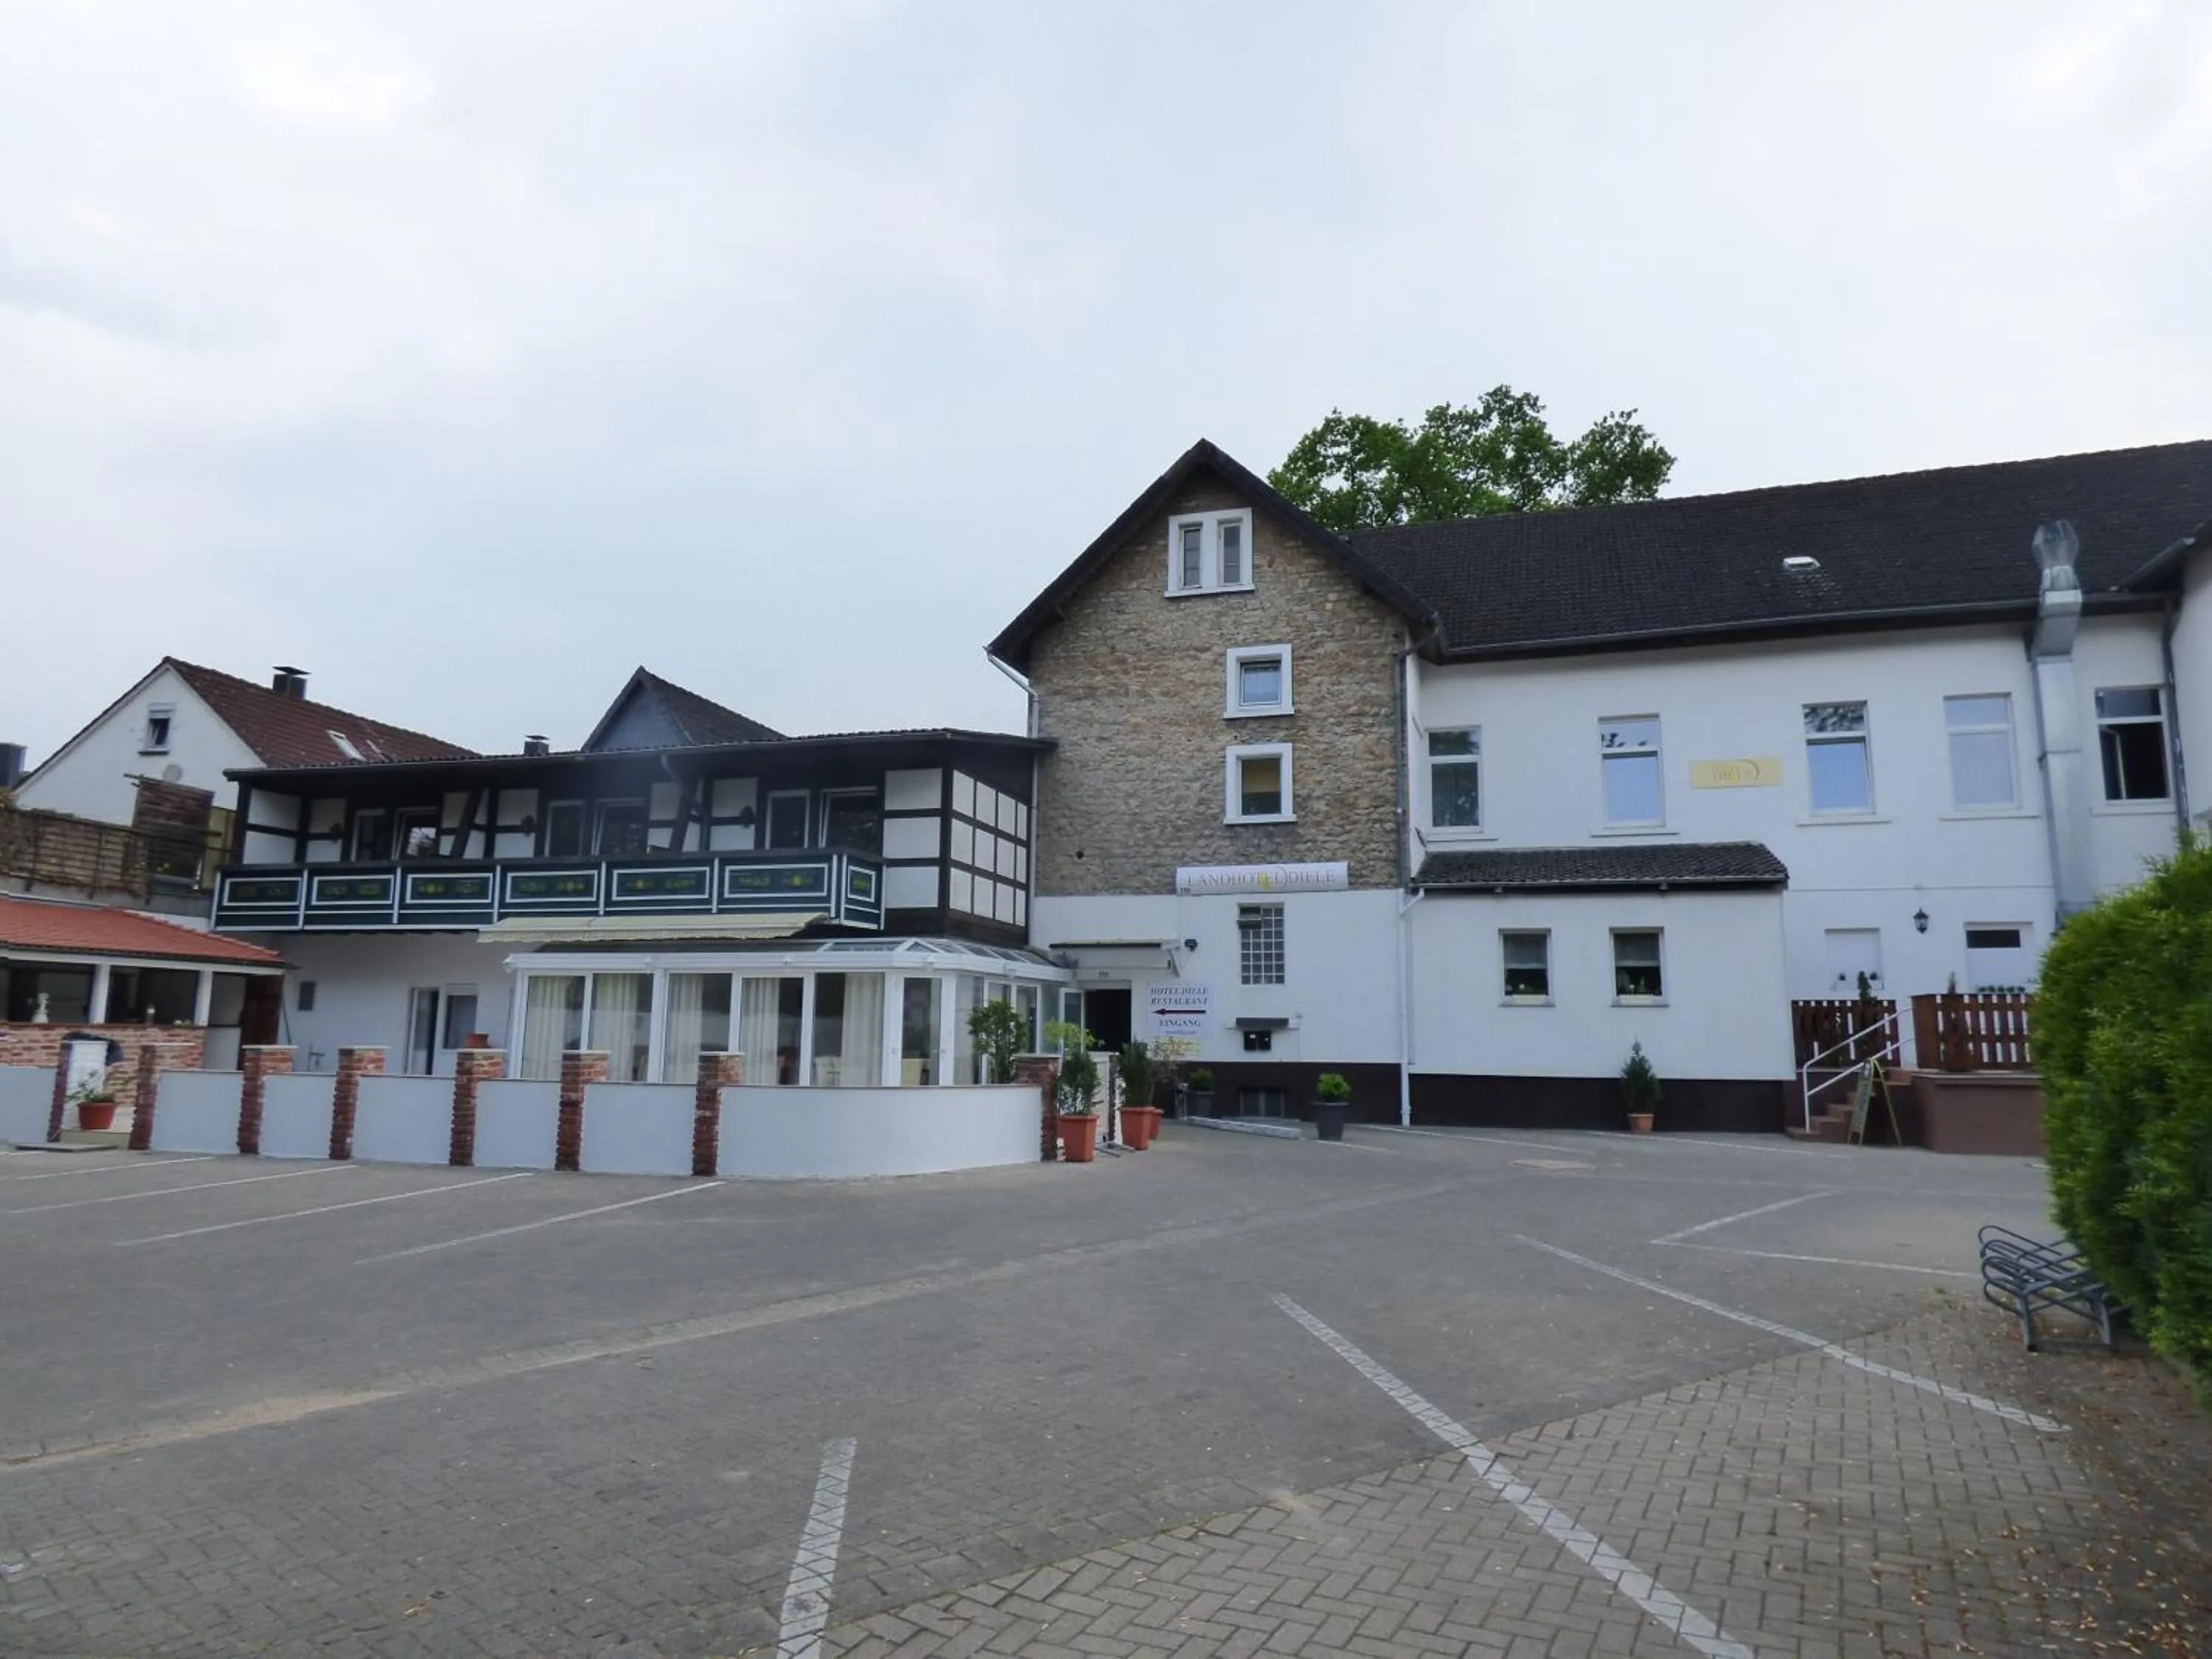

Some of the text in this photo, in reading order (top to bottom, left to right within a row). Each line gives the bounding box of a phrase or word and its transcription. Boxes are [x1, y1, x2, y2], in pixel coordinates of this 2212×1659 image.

[1186, 871, 1284, 886] LANDHOTEL
[1150, 997, 1208, 1006] RESTAURANT
[1158, 1019, 1202, 1028] EINGANG
